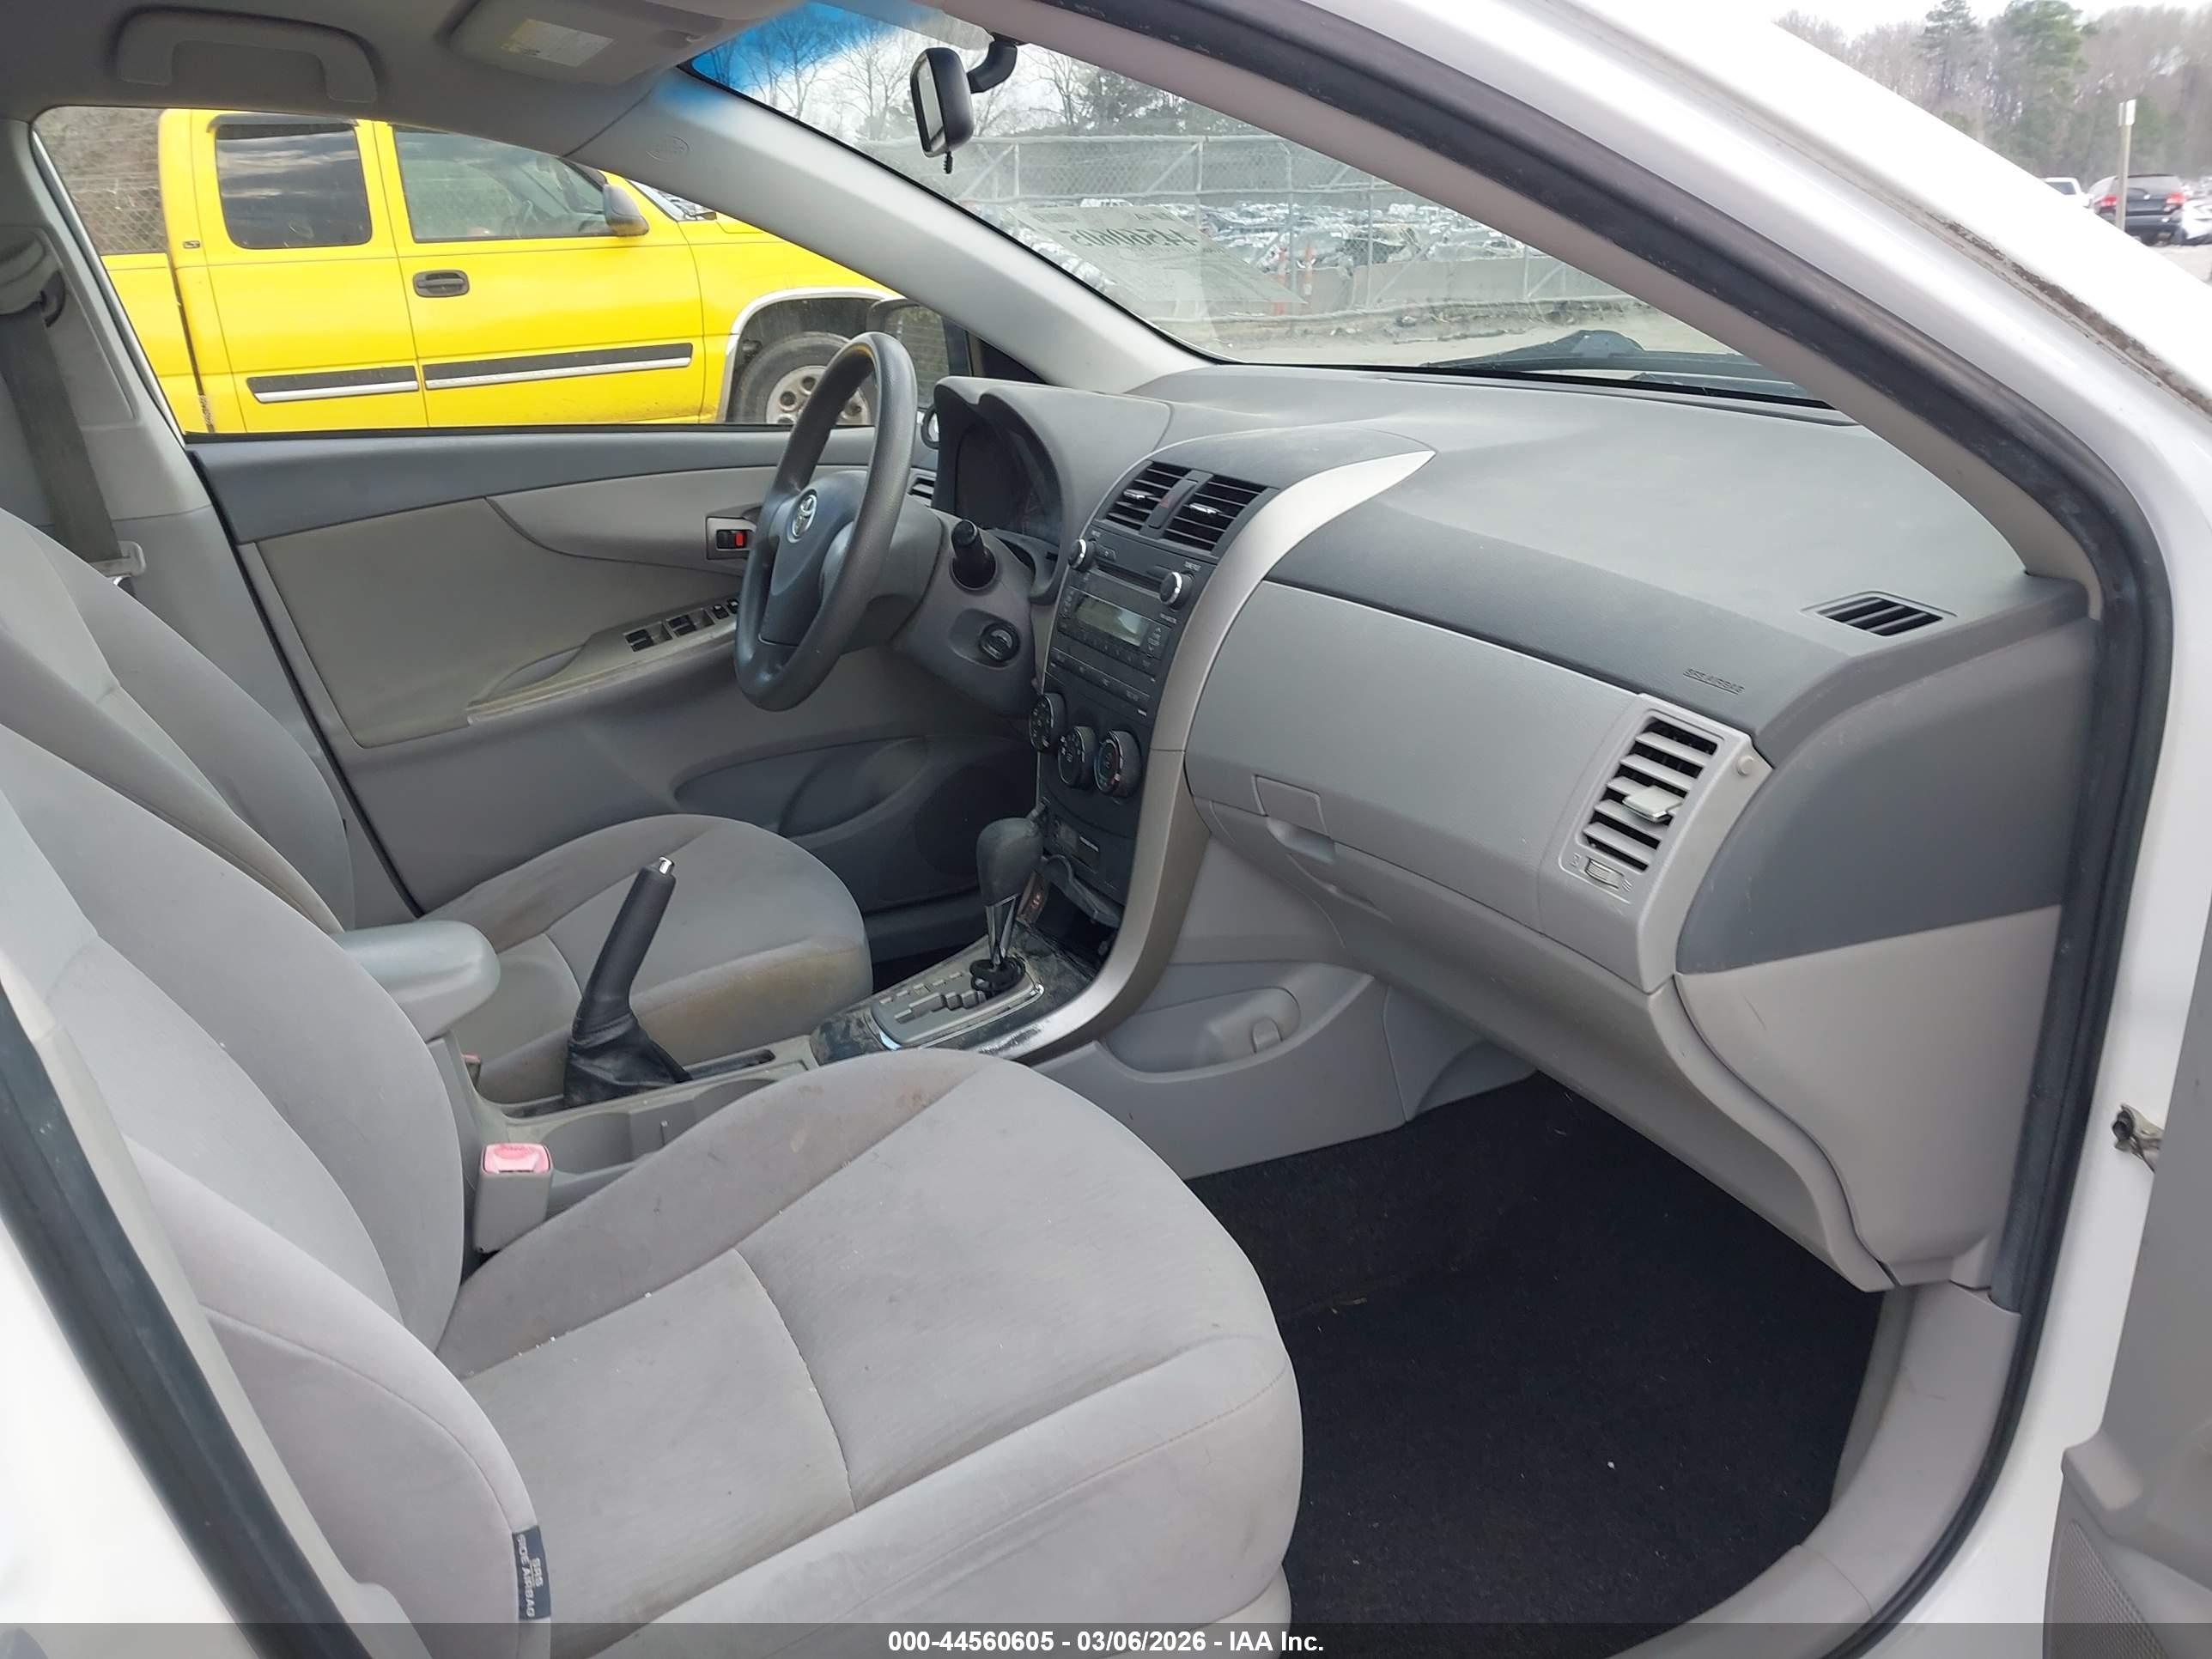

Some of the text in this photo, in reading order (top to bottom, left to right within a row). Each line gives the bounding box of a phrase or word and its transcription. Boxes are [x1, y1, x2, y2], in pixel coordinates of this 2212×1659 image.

[517, 1534, 536, 1618] SIDE AIRBAG
[532, 1558, 544, 1587] SRS
